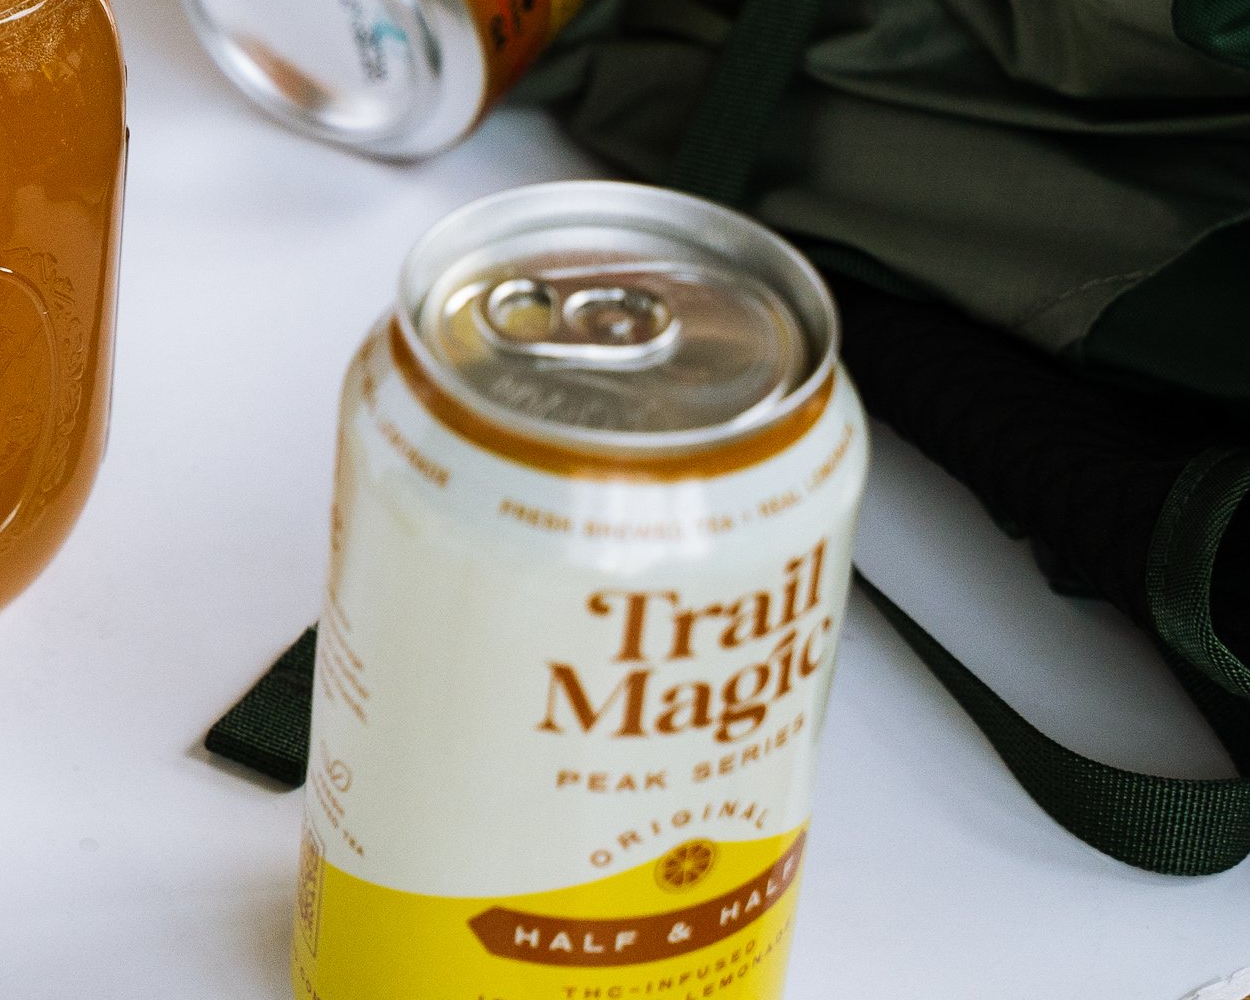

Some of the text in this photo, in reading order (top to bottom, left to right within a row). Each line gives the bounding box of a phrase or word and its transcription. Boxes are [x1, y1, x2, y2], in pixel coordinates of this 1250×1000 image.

[586, 537, 829, 664] Trail
[533, 614, 834, 745] Magic
[556, 715, 806, 793] PEAK SERIES
[589, 802, 769, 868] ORIGINAL
[514, 855, 799, 953] HALF & HALF
[564, 939, 756, 999] THC-INFUSED
